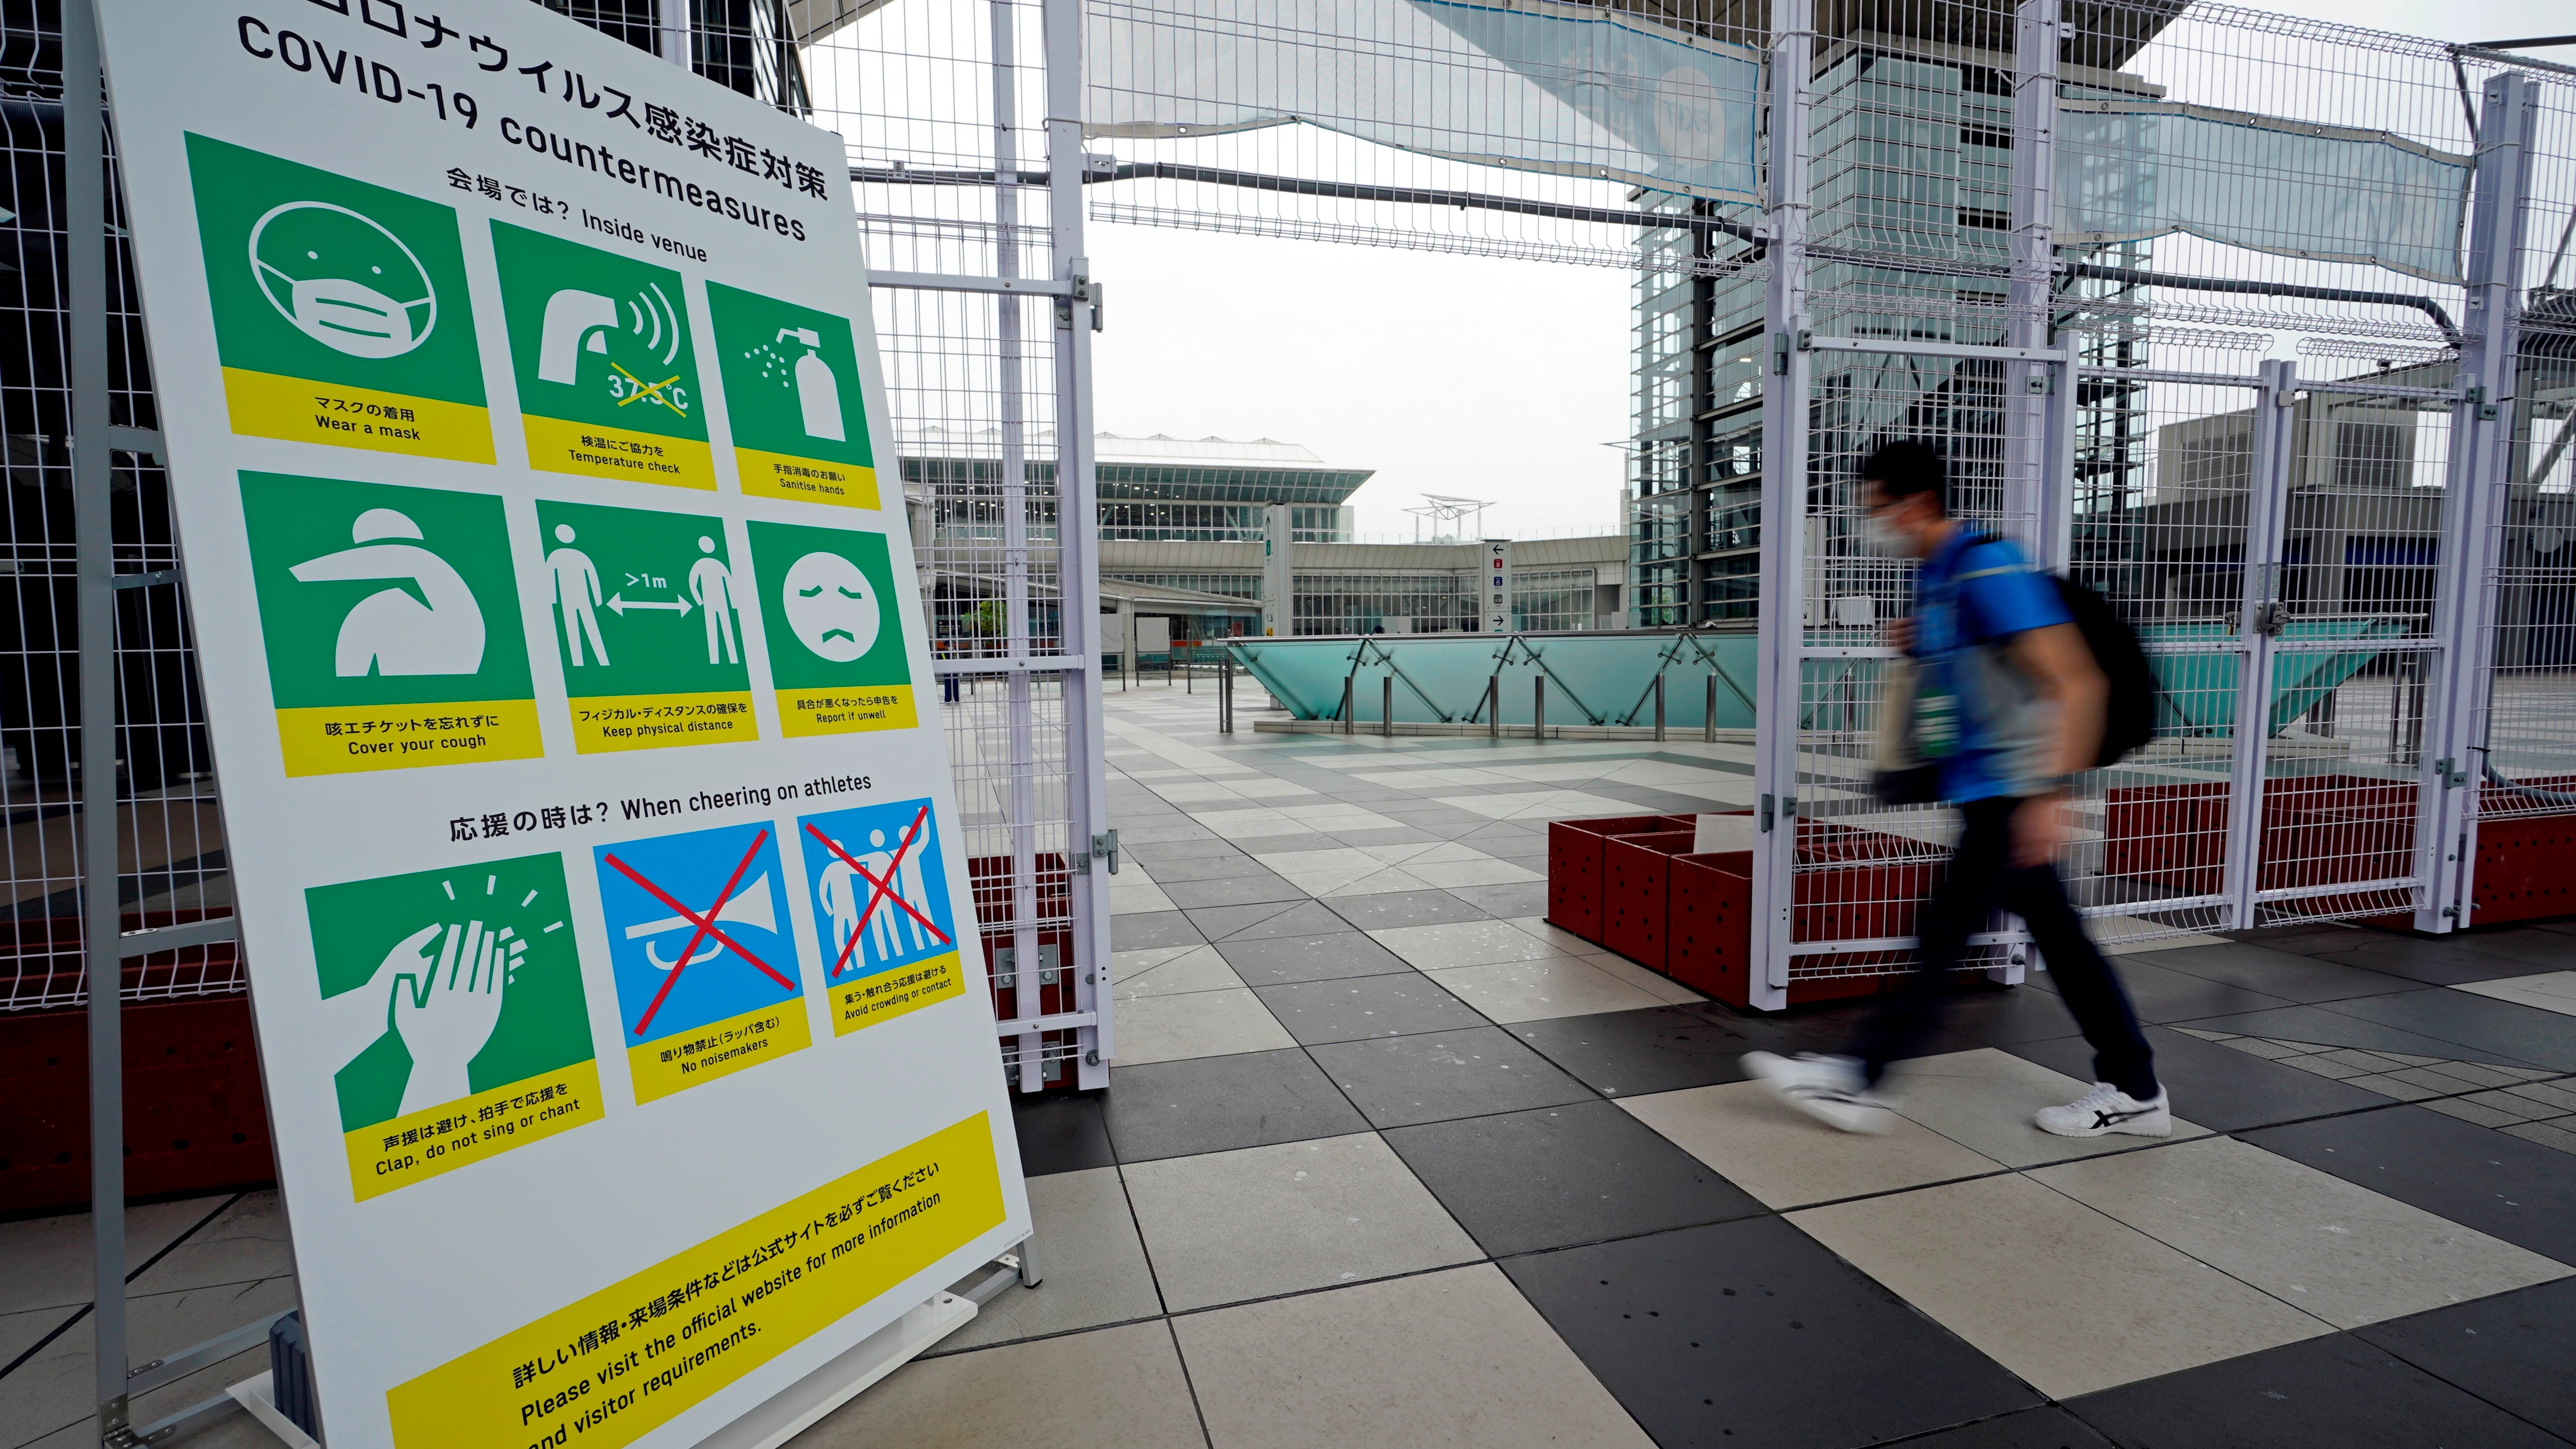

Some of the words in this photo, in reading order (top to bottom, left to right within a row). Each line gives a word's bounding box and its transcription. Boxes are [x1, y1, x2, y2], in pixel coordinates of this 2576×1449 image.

[238, 15, 477, 129] COVID-19
[501, 117, 805, 241] countermeasures
[582, 208, 644, 243] Inside
[651, 234, 707, 262] venue
[315, 397, 415, 422] マスクの着用
[315, 415, 357, 432] Wear
[364, 424, 373, 434] a
[379, 426, 420, 440] mask
[581, 435, 663, 457] 検温にご協力を
[568, 450, 644, 469] Temperature
[648, 461, 680, 474] check
[773, 464, 845, 481] 手指消毒のお願い
[780, 478, 816, 491] Sanitise
[819, 484, 844, 495] hands
[625, 572, 667, 588] >1m
[797, 696, 898, 710] 具合が悪くなったら申告を
[325, 715, 499, 736] 咳エチケットを忘れずに
[603, 726, 632, 738] Keep
[637, 722, 684, 737] physical
[688, 721, 733, 732] distance
[816, 713, 846, 724] Report
[848, 711, 854, 720] if
[858, 710, 886, 720] unwell
[348, 742, 394, 754] Cover
[400, 740, 434, 753] your
[441, 734, 486, 749] cough
[620, 798, 681, 820] When
[689, 786, 771, 811] cheering
[778, 785, 798, 800] on
[804, 775, 871, 796] athletes
[845, 1004, 868, 1021] Avoid
[871, 993, 909, 1011] crowding
[911, 990, 919, 998] or
[922, 978, 951, 994] contact
[681, 1062, 696, 1074] No
[701, 1039, 768, 1068] noisemakers
[383, 1084, 568, 1152] 声援は避け、拍手で応援を
[376, 1155, 419, 1175] Clap,
[426, 1145, 445, 1159] do
[452, 1132, 478, 1151] not
[483, 1121, 514, 1140] sing
[520, 1115, 534, 1127] or
[540, 1099, 580, 1121] chant
[521, 1379, 590, 1426] Please
[597, 1351, 639, 1385] visit
[644, 1334, 676, 1359] the
[682, 1297, 737, 1340] official
[741, 1267, 802, 1307] website
[806, 1252, 826, 1273] for
[831, 1233, 865, 1260] more
[869, 1193, 940, 1239] information
[574, 1388, 635, 1434] visitor
[643, 1322, 761, 1397] requirements.
